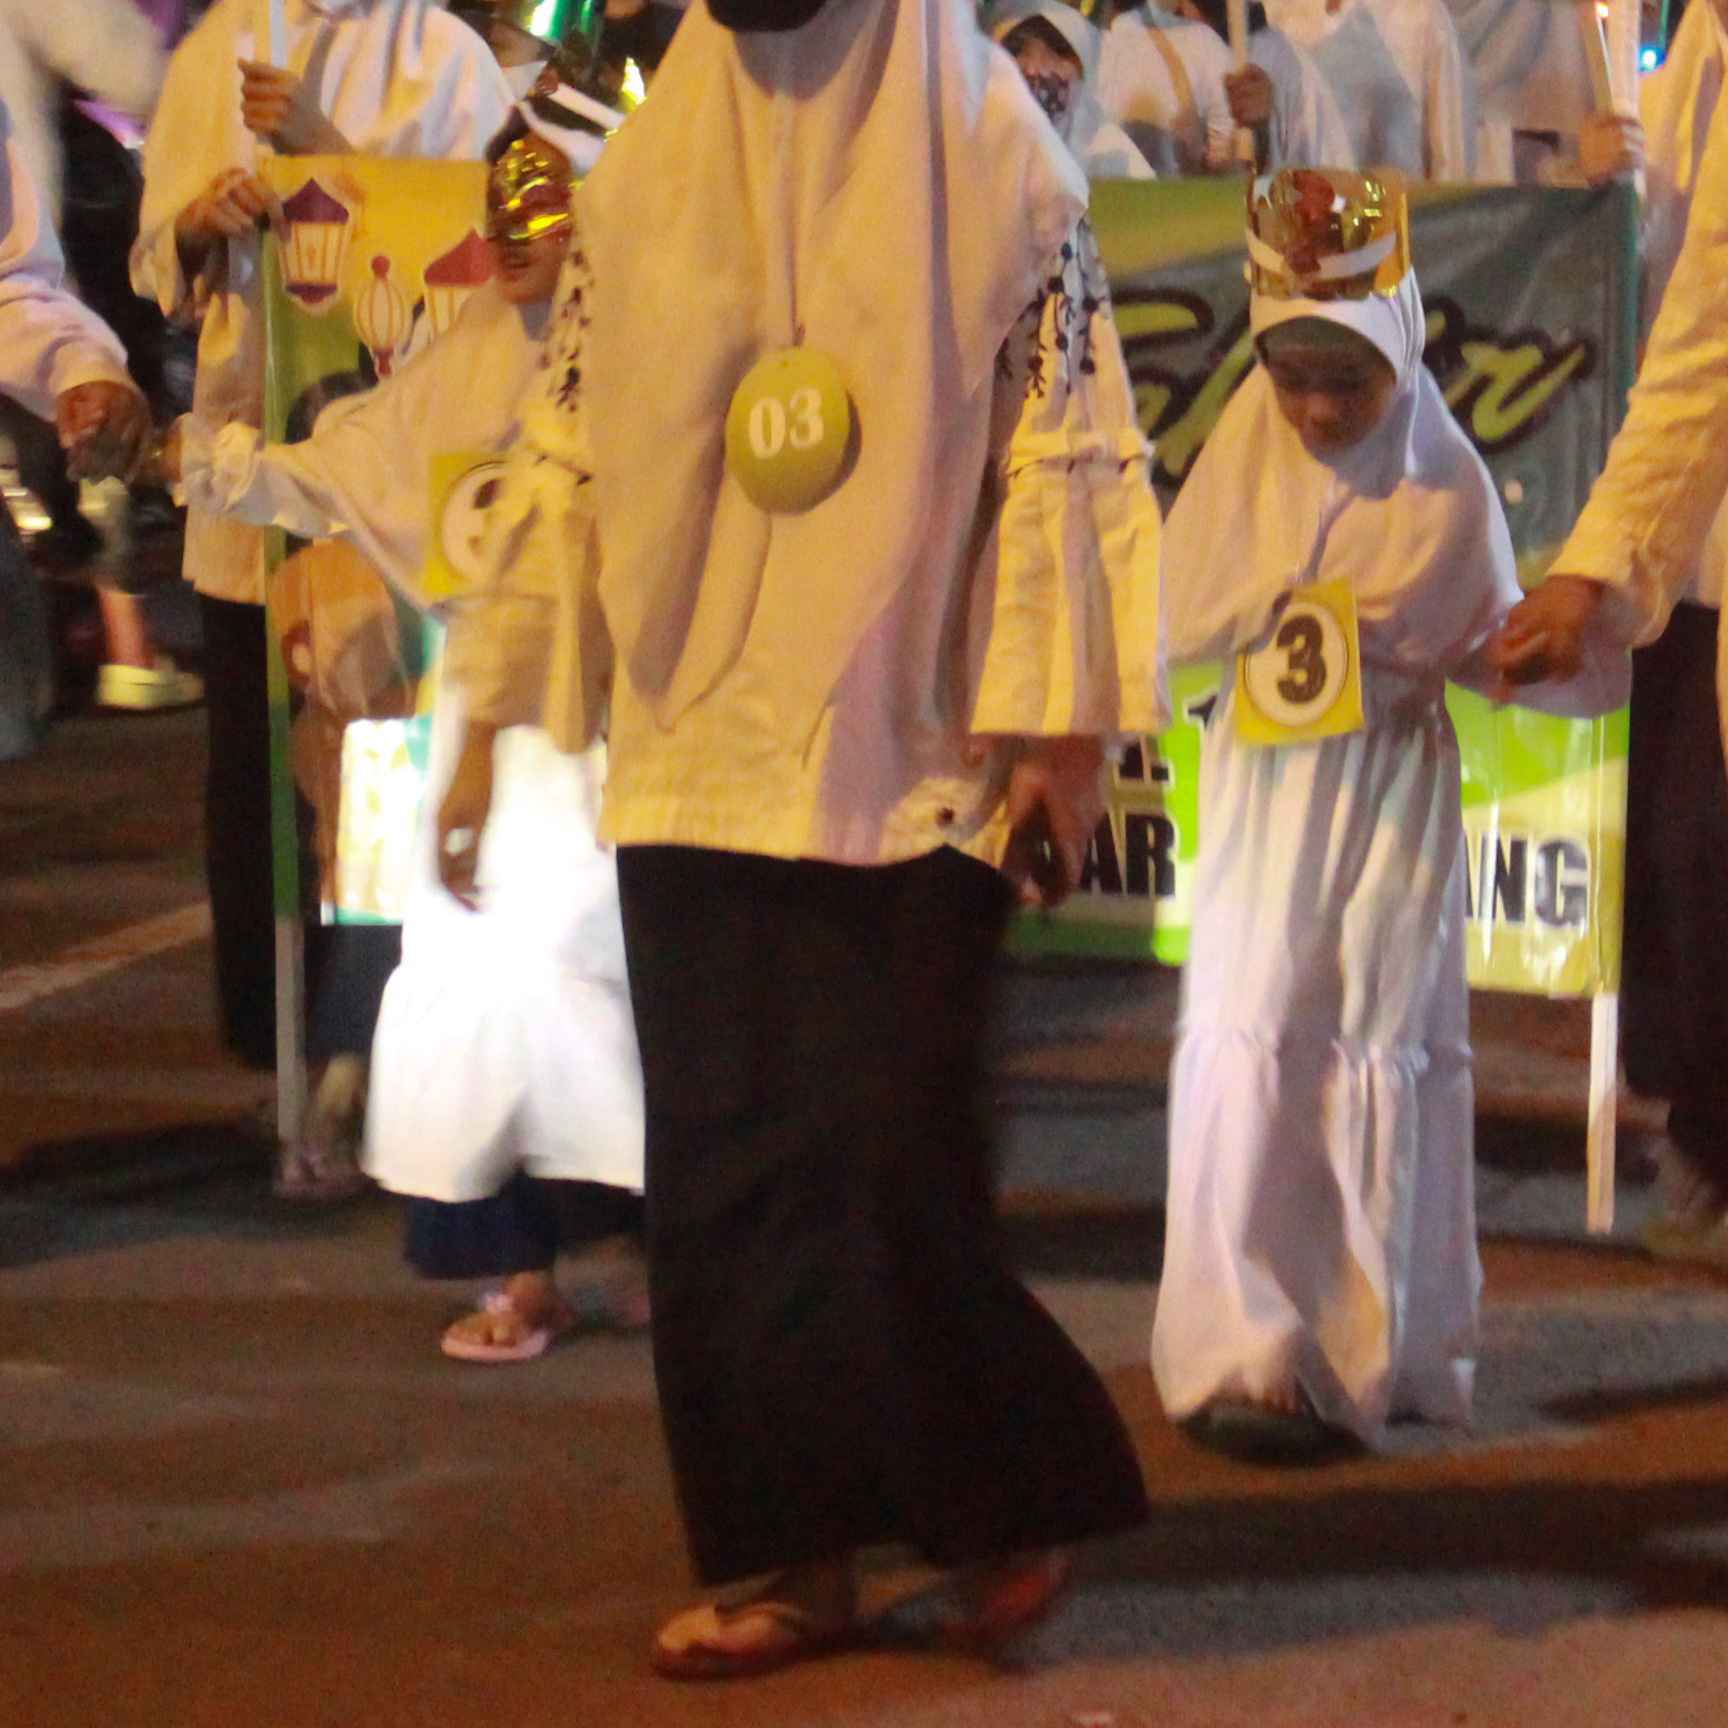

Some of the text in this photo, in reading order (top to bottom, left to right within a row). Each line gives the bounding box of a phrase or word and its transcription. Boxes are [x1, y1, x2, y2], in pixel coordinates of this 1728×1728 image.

[748, 386, 825, 460] 03
[1276, 613, 1328, 705] 3
[1465, 833, 1590, 928] NG
